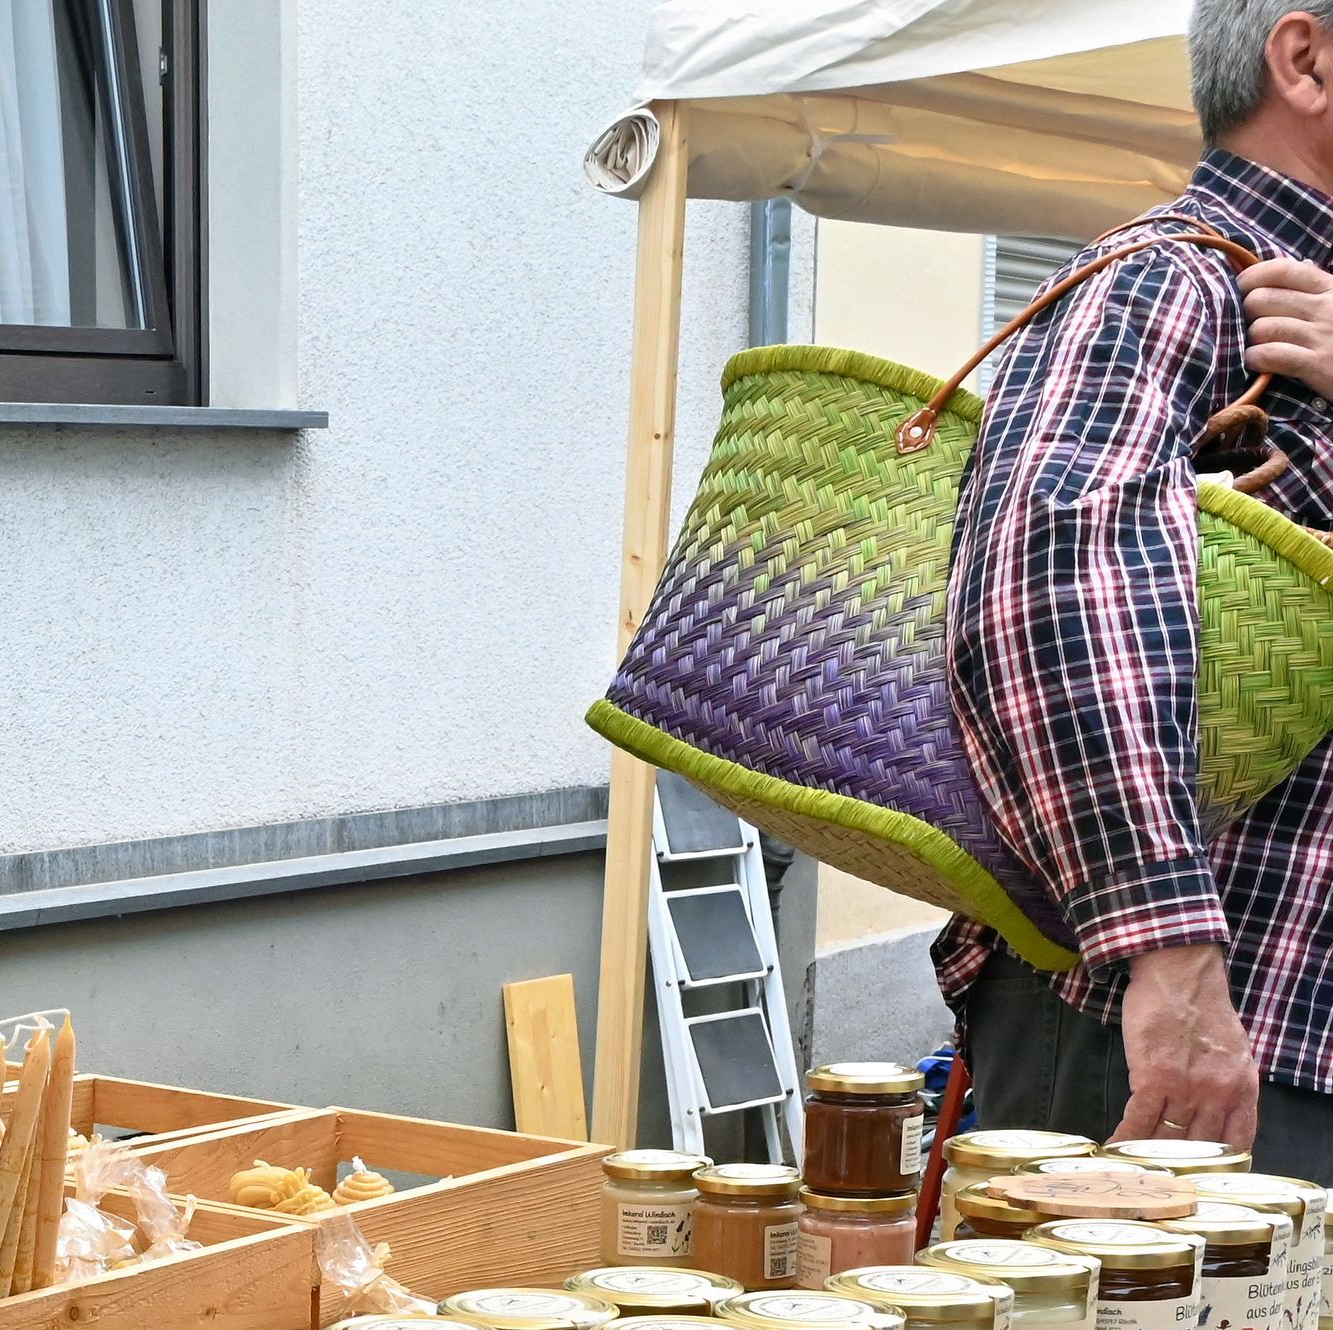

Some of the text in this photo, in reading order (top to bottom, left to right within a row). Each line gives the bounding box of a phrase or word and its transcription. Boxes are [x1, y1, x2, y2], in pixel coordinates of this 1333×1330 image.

[645, 1210, 676, 1219] Windisch
[1248, 1282, 1282, 1299] Blüten
[1246, 1308, 1267, 1320] aus
